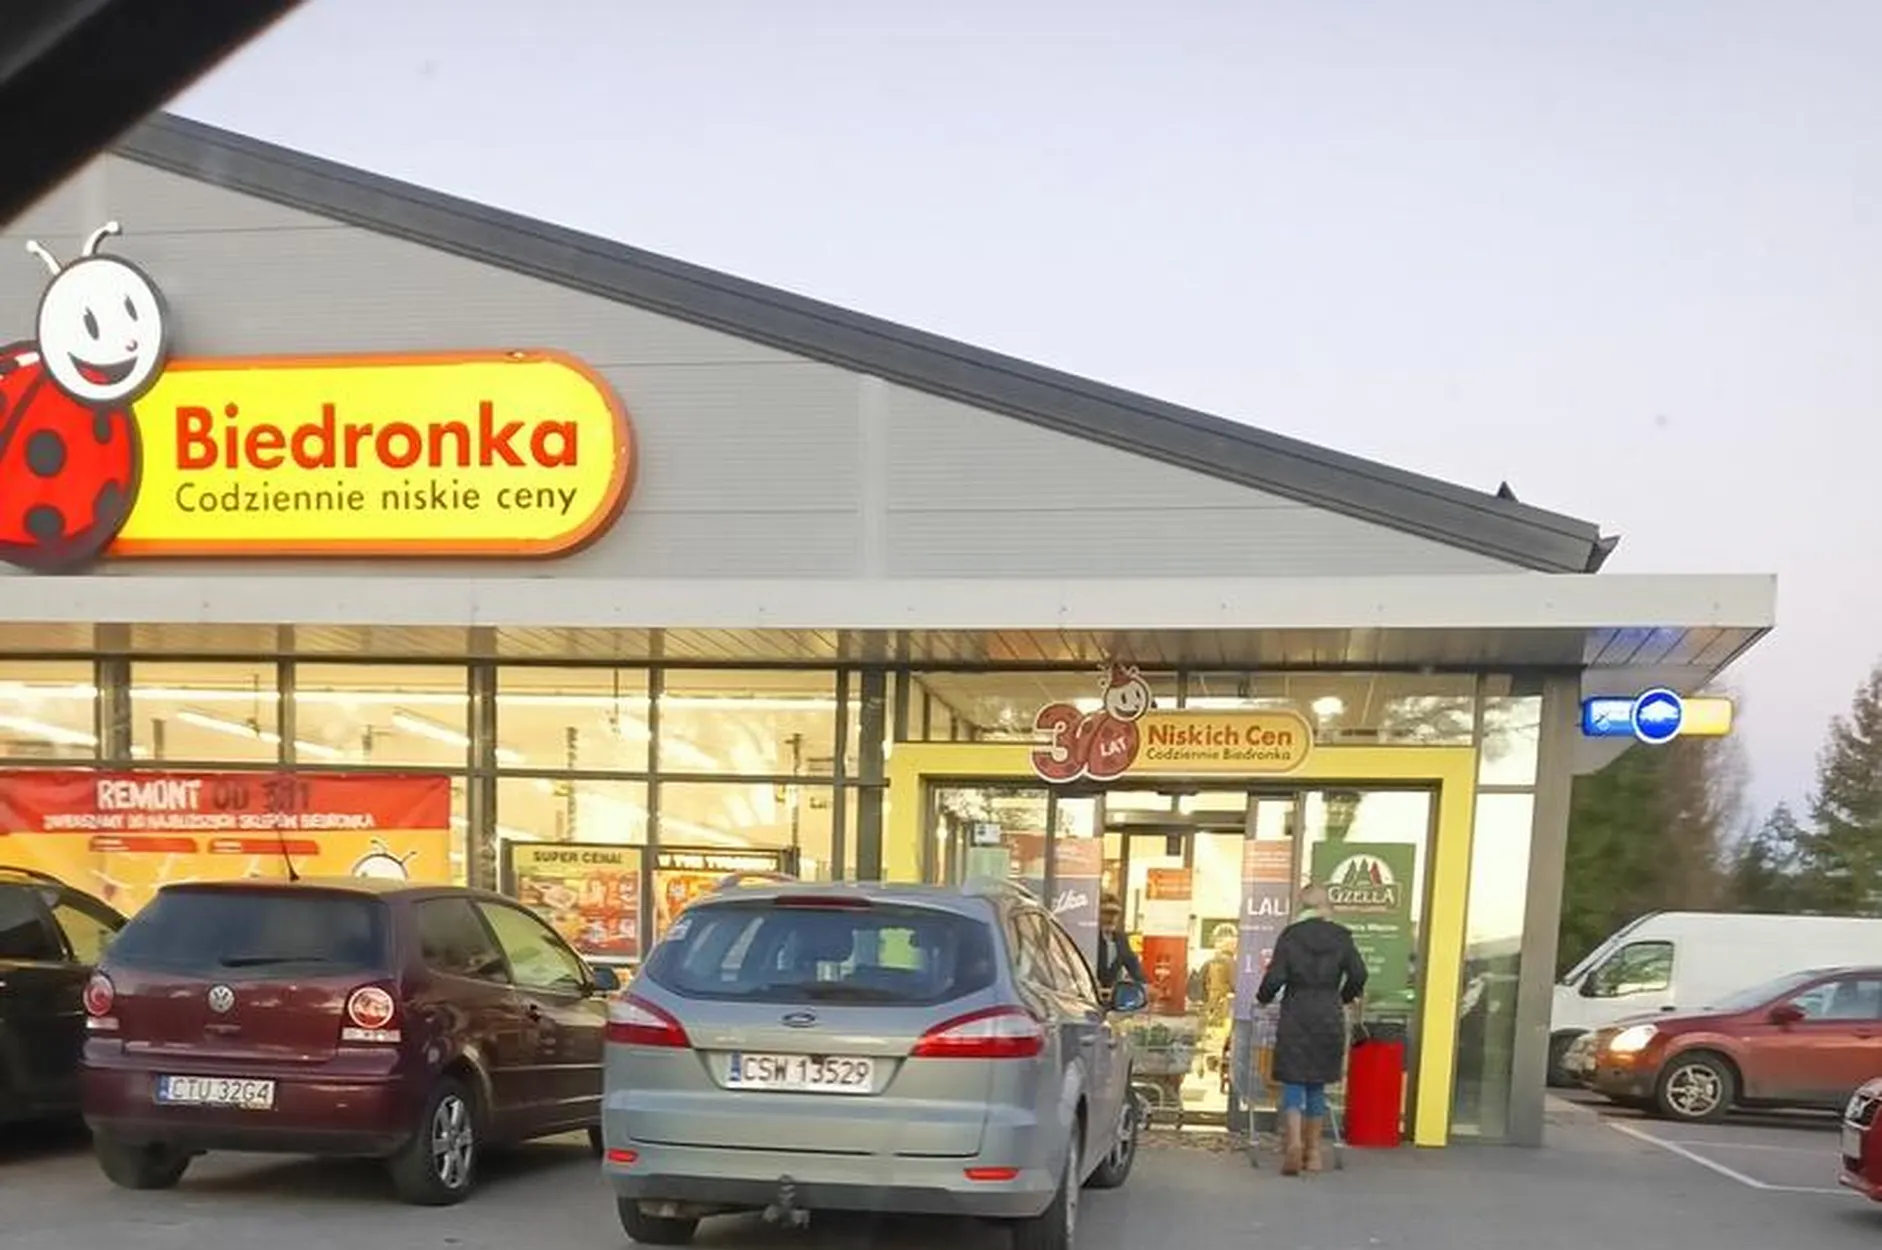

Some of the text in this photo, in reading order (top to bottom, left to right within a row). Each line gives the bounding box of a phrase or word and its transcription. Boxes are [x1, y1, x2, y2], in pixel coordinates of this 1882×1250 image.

[175, 400, 579, 470] Biedronka
[176, 478, 579, 516] Codziennie niskie ceny
[1148, 724, 1293, 746] Niskich Cen
[1100, 738, 1127, 757] LAT
[1146, 747, 1292, 761] Codziennie Biedronka
[97, 779, 203, 810] REMONT
[533, 851, 623, 864] SUPER CENA!
[744, 1056, 870, 1085] CSW 13529
[172, 1078, 211, 1100] CTU
